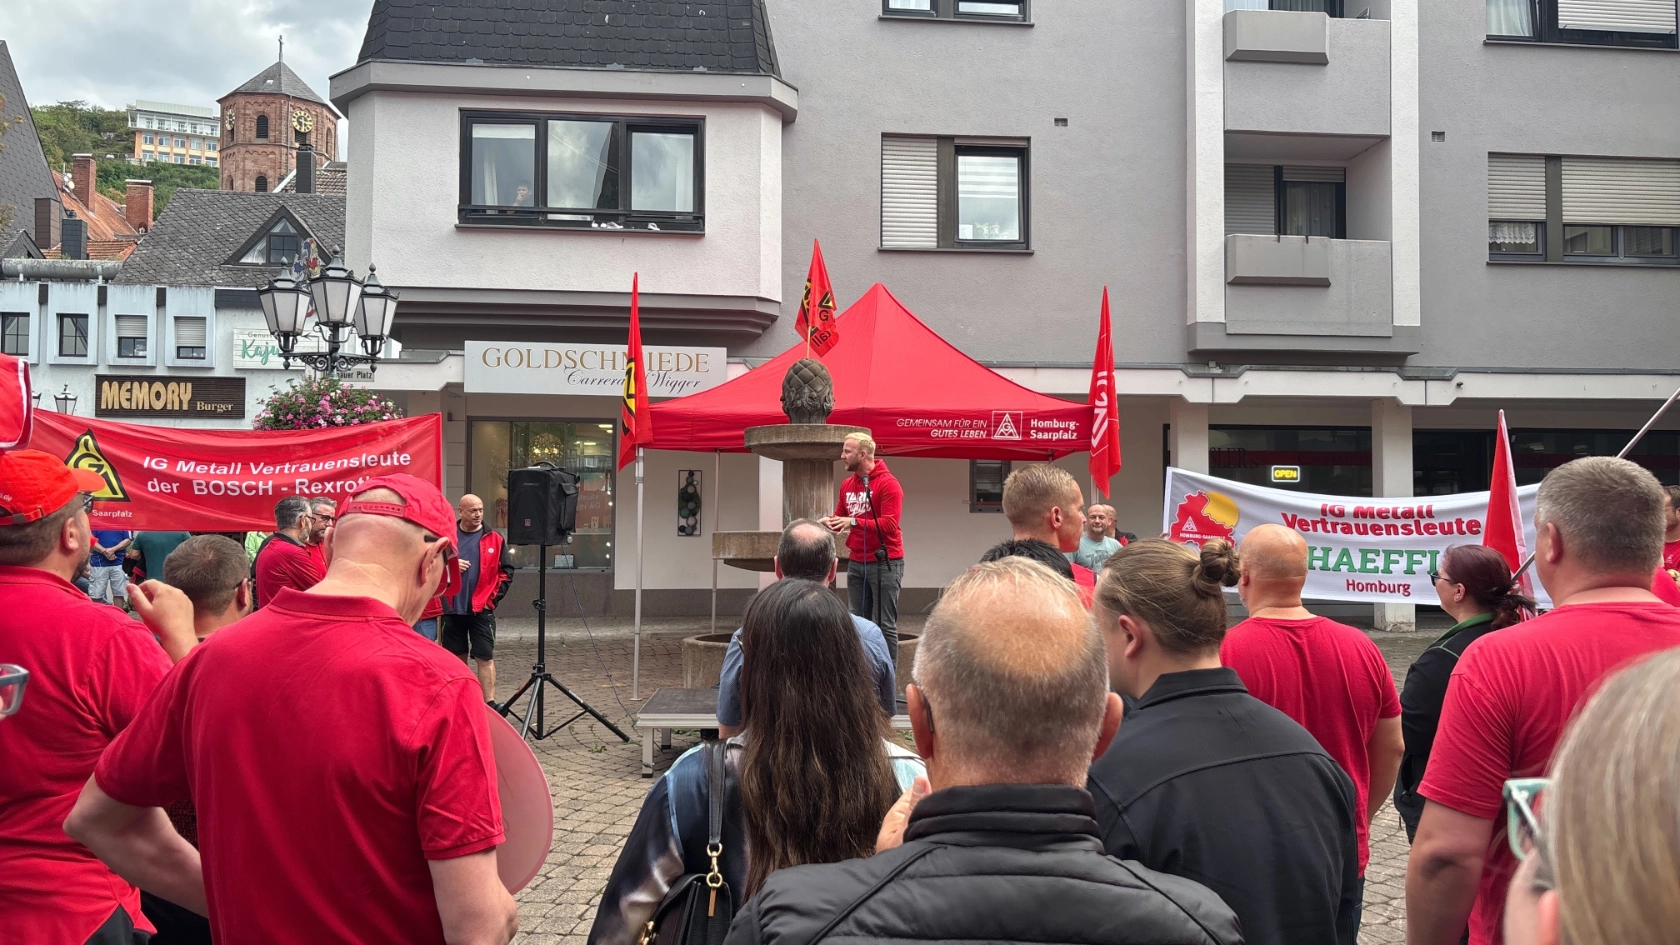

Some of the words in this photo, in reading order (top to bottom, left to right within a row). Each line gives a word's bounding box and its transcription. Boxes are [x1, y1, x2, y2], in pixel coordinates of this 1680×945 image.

[356, 370, 373, 380] Platz
[645, 369, 701, 395] Wigger
[100, 380, 193, 411] MEMORY
[195, 401, 234, 413] Burger
[896, 418, 952, 428] GEMEINSAM
[953, 417, 971, 428] FÜR
[972, 419, 988, 428] EIN
[1030, 418, 1080, 431] Homburg-
[930, 429, 958, 438] GUTES
[960, 429, 988, 439] LEBEN
[1029, 429, 1078, 442] Saarpfalz
[143, 456, 169, 470] IG
[175, 460, 242, 475] Metall
[249, 450, 412, 475] Vertrauensleute
[1274, 469, 1297, 479] OPEN
[147, 478, 180, 494] der
[192, 479, 274, 496] BOSCH
[295, 475, 371, 495] Rexrot
[92, 509, 133, 519] Saarpfalz
[1320, 503, 1346, 518] IG
[1352, 504, 1436, 520] Metall
[1280, 511, 1482, 536] Vertrauensleute
[1306, 545, 1441, 575] HAEFFL
[1345, 578, 1412, 597] Homburg
